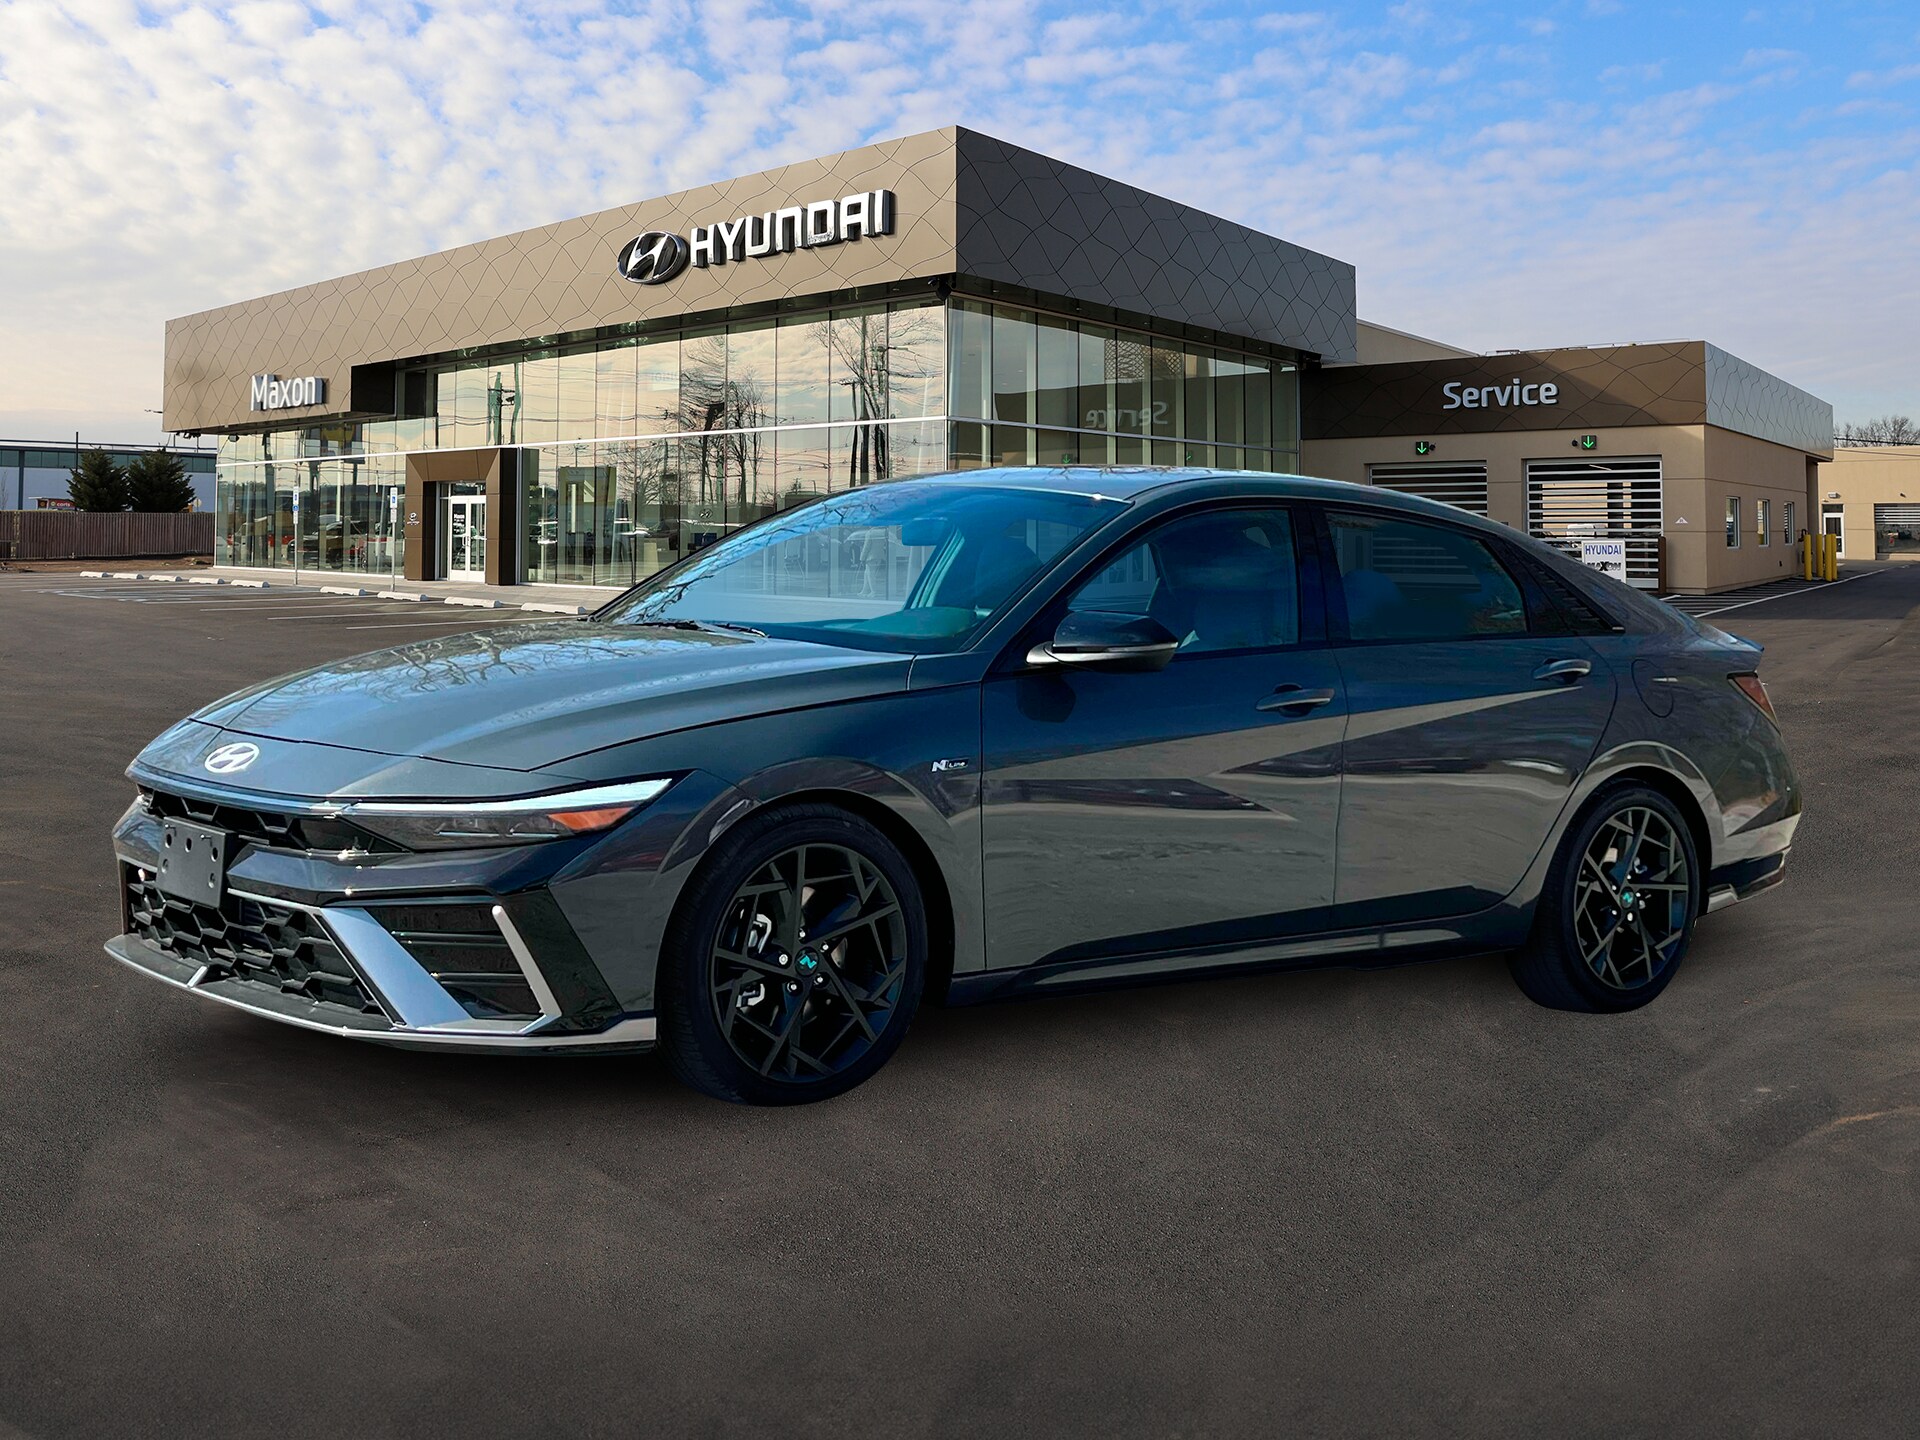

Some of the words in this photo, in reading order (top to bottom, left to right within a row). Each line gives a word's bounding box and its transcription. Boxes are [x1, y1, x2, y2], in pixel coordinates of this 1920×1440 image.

[691, 189, 890, 267] HYUNDAI
[251, 374, 318, 411] Maxon
[1443, 378, 1558, 409] Service
[1585, 545, 1621, 554] HYUNDAI
